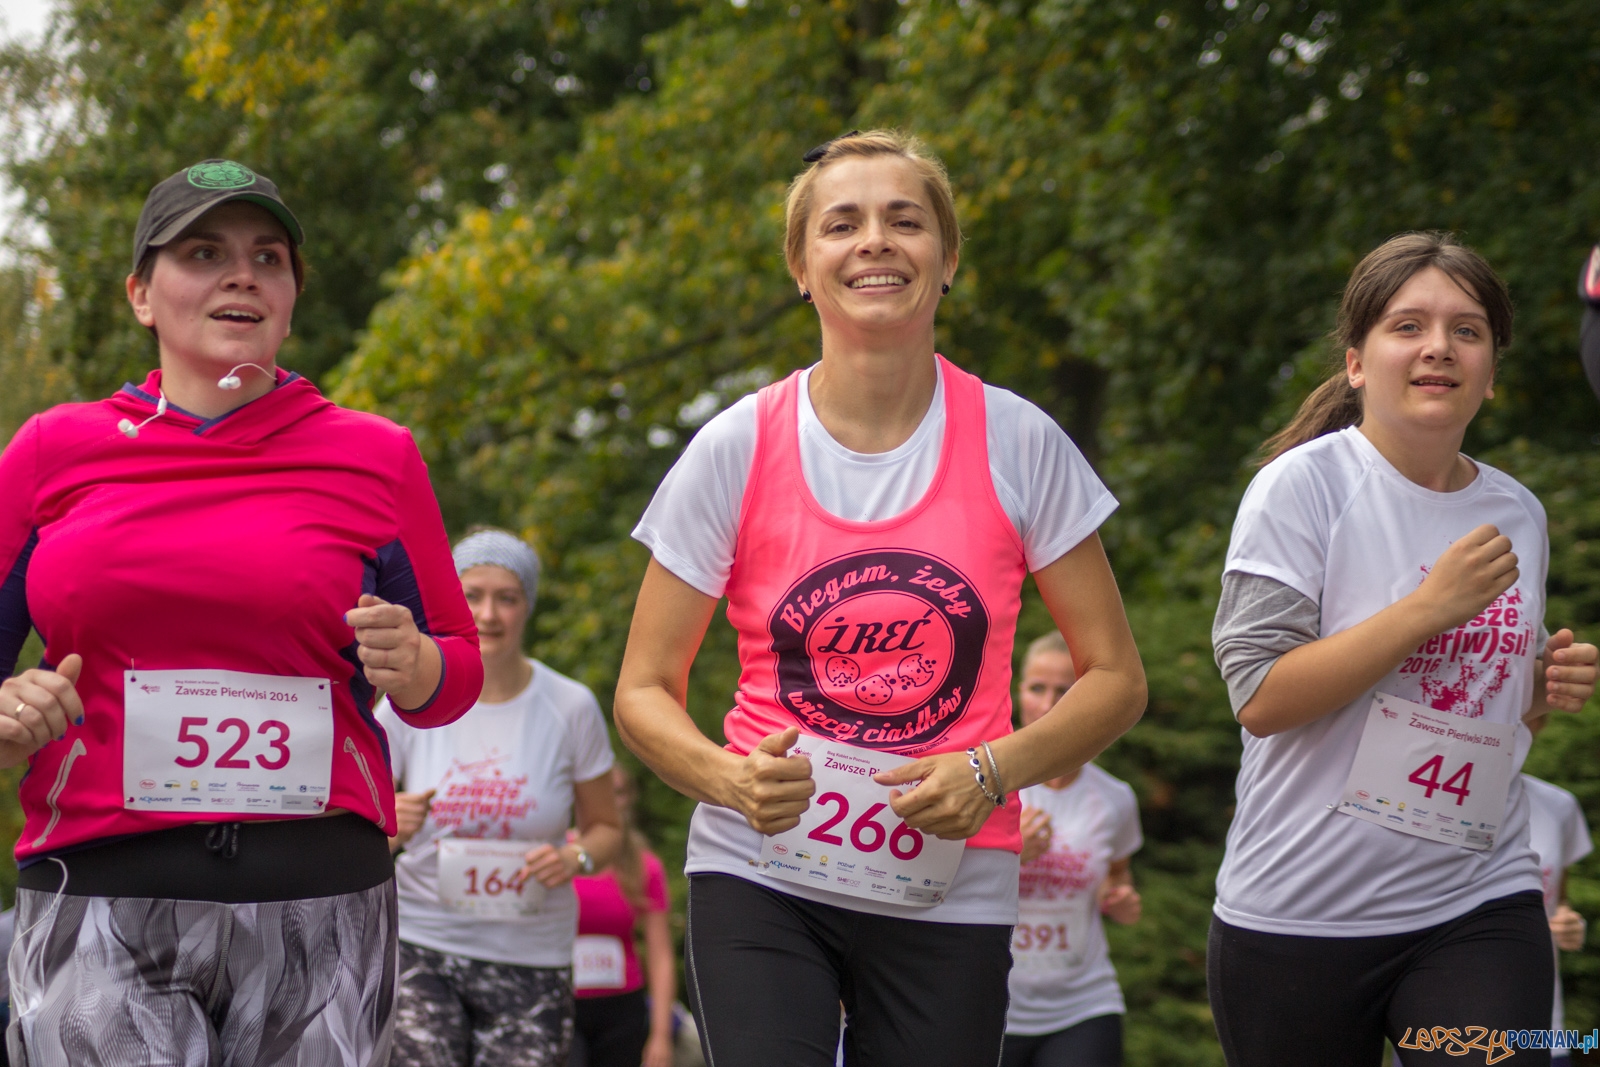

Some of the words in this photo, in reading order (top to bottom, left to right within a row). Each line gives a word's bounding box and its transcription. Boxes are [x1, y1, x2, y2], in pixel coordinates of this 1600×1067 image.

[780, 564, 899, 634] Biegam,
[909, 565, 971, 618] żeby
[817, 608, 935, 654] ŻREĆ
[1398, 657, 1442, 674] 2016
[175, 686, 217, 696] Zawsze
[221, 687, 267, 700] Pier(w)si
[269, 691, 298, 702] 2016
[787, 691, 862, 740] więcej
[862, 686, 962, 742] ciastków
[1409, 717, 1445, 735] Zawsze
[1447, 728, 1482, 744] Pier(w)si
[1483, 736, 1500, 747] 2016
[174, 716, 291, 770] 523
[824, 757, 866, 775] Zawsze
[1408, 754, 1474, 806] 44
[807, 791, 924, 861] 266
[464, 866, 525, 897] 164
[1014, 924, 1069, 951] 391
